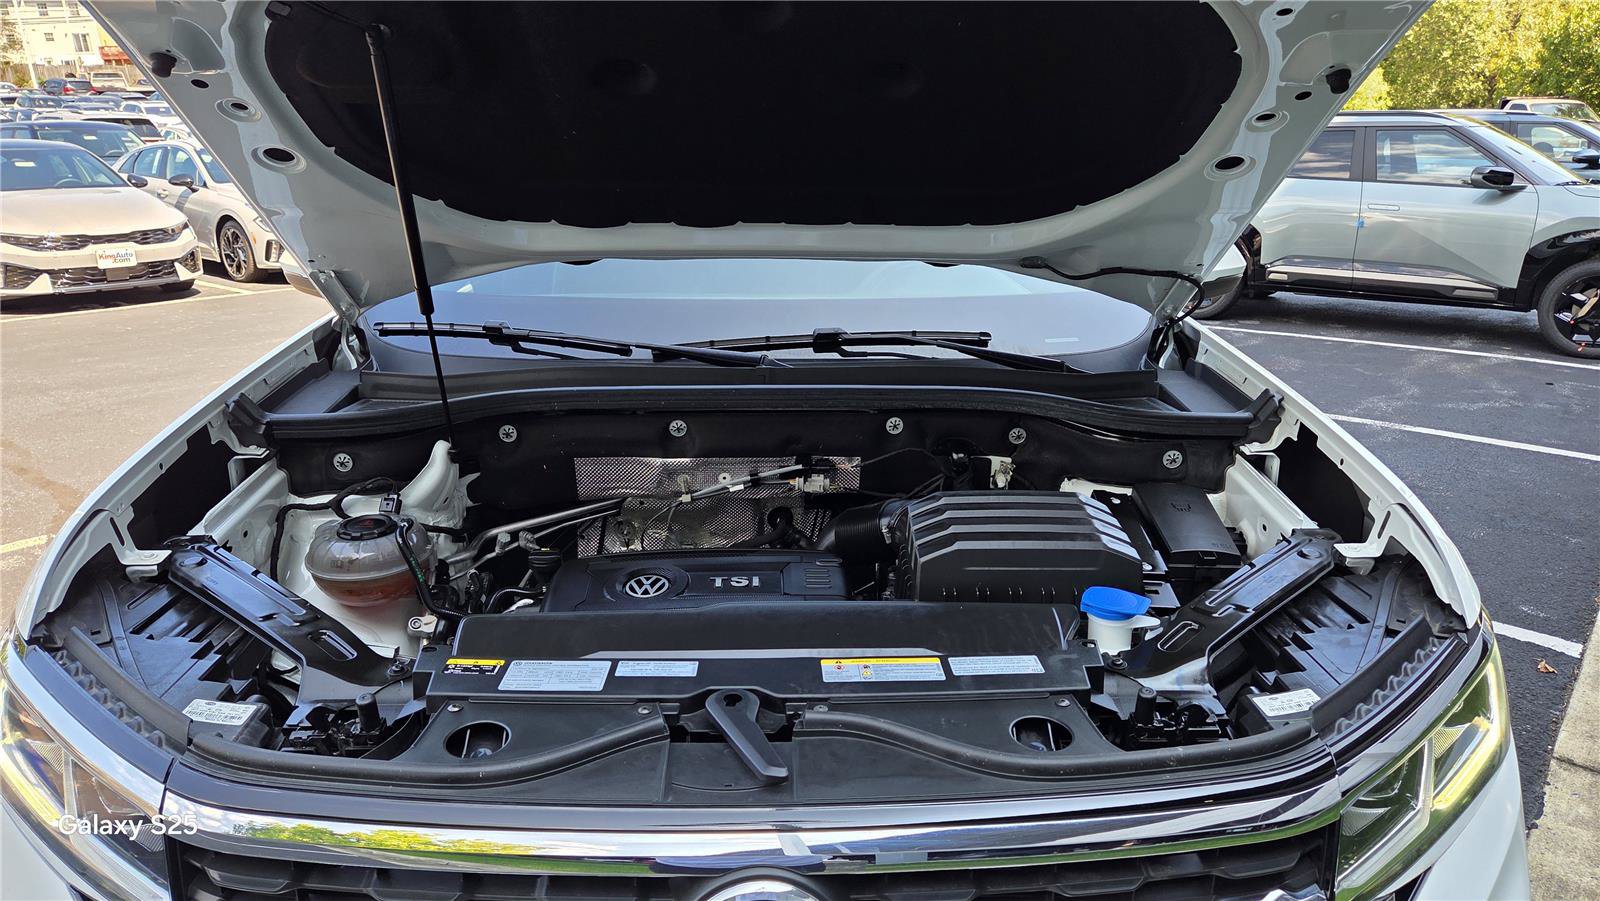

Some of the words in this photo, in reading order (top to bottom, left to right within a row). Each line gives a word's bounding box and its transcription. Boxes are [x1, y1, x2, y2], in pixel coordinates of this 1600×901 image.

[98, 251, 133, 261] KingAuto
[625, 575, 669, 598] VW
[709, 576, 760, 588] TSI
